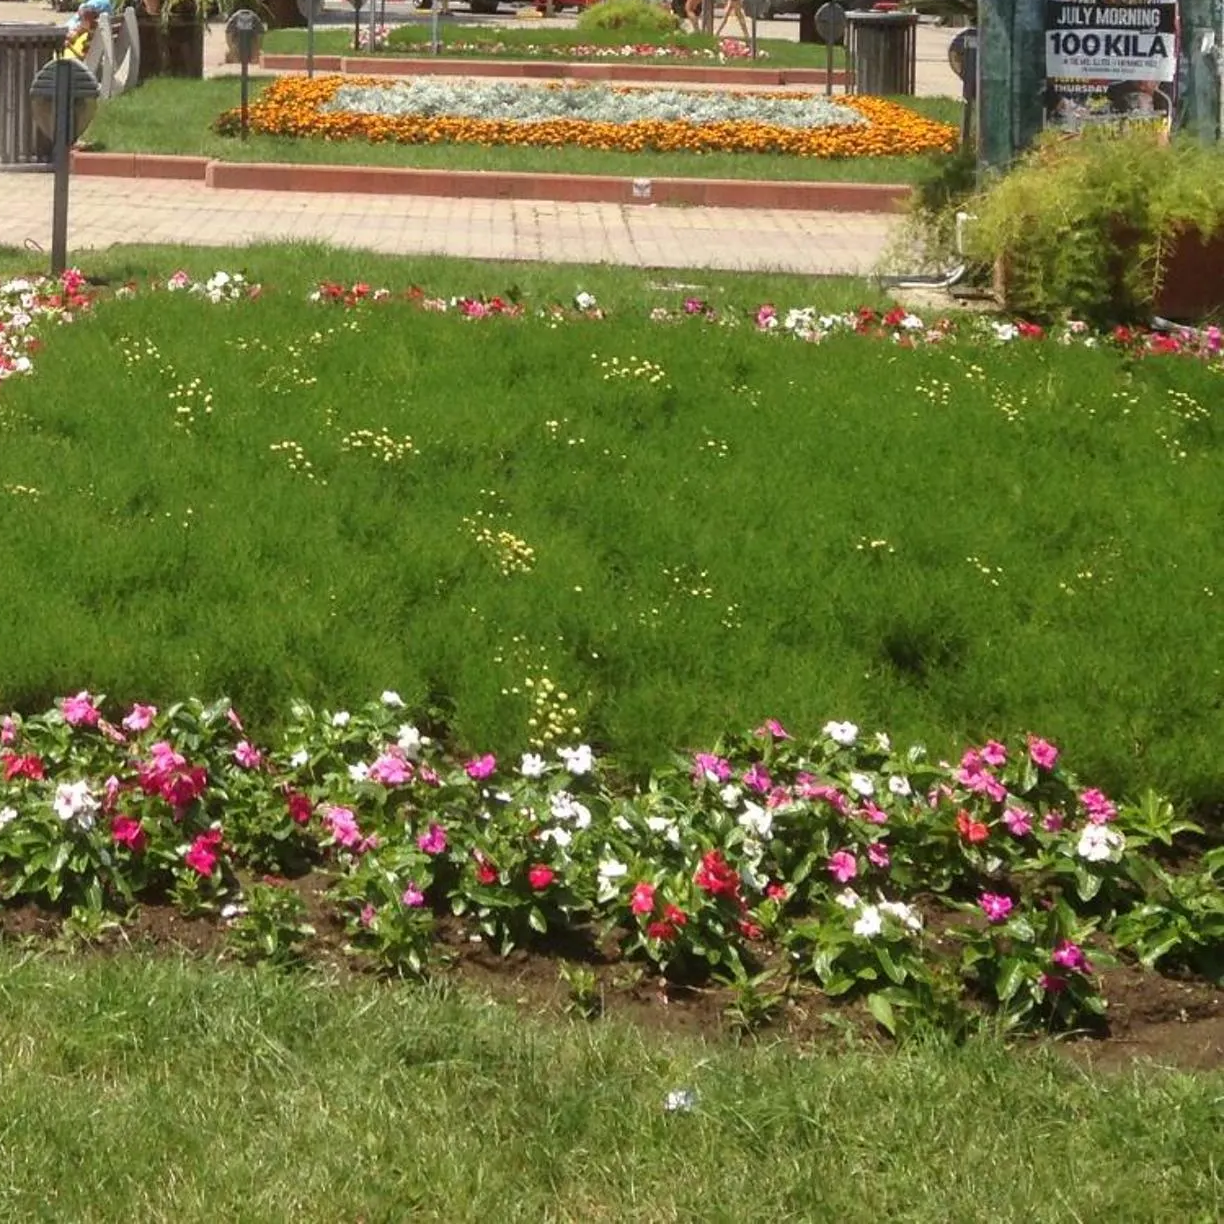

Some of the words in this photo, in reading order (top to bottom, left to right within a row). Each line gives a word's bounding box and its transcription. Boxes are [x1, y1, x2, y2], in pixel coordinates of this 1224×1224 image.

[1057, 8, 1094, 26] JULY
[1095, 8, 1161, 27] MORNING
[1050, 31, 1101, 56] 100
[1104, 33, 1169, 58] KILA
